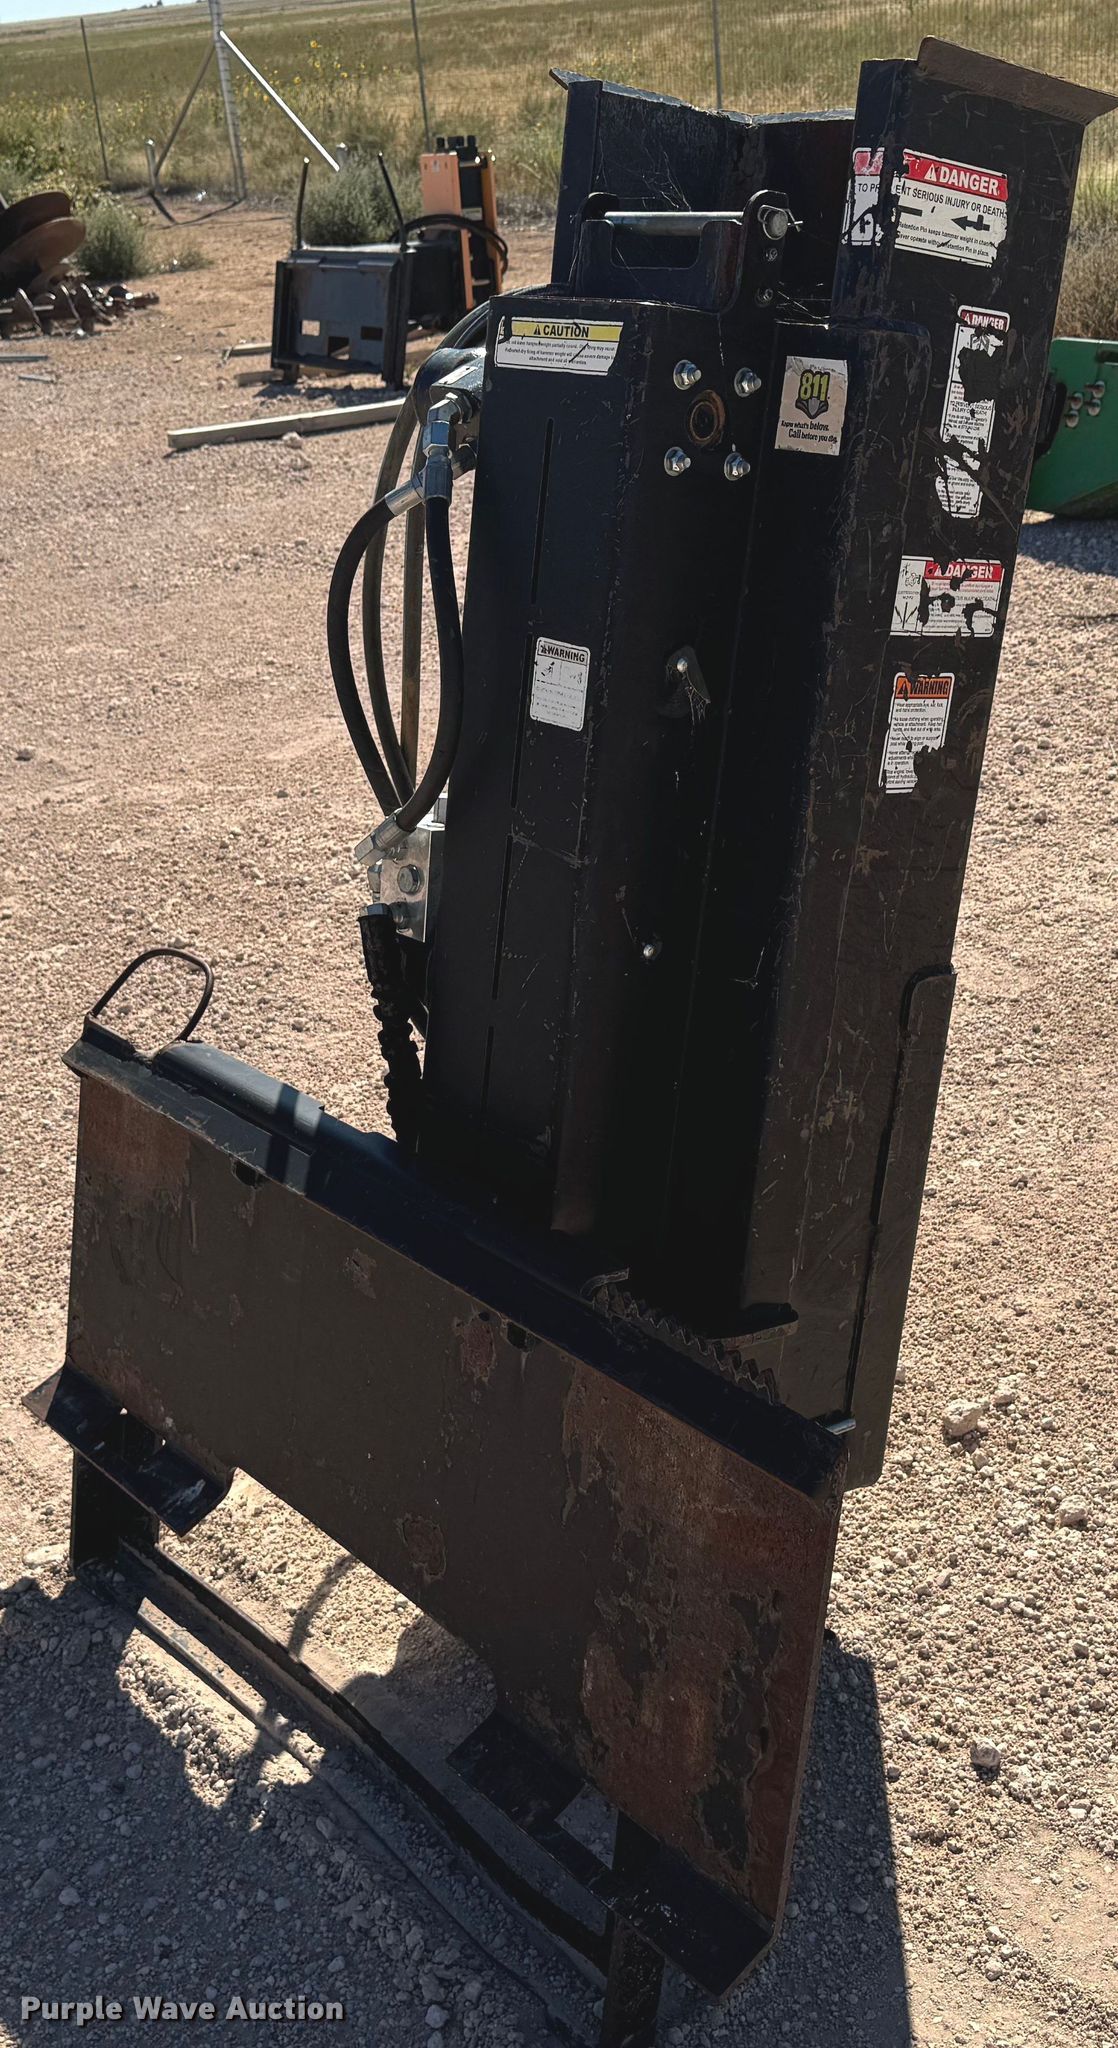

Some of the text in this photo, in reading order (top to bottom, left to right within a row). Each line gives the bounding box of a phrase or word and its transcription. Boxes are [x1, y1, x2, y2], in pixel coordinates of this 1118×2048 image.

[938, 167, 999, 196] DANGER
[858, 183, 868, 192] TO
[869, 183, 912, 197] PRENT
[912, 187, 944, 204] SERIOUS
[945, 195, 970, 210] INJURY
[971, 201, 981, 213] OR
[543, 324, 589, 338] CAUTION
[800, 371, 830, 401] 811
[781, 420, 829, 431] Know what's below.
[788, 429, 801, 438] Call
[801, 431, 818, 440] before
[547, 645, 585, 662] WARNING
